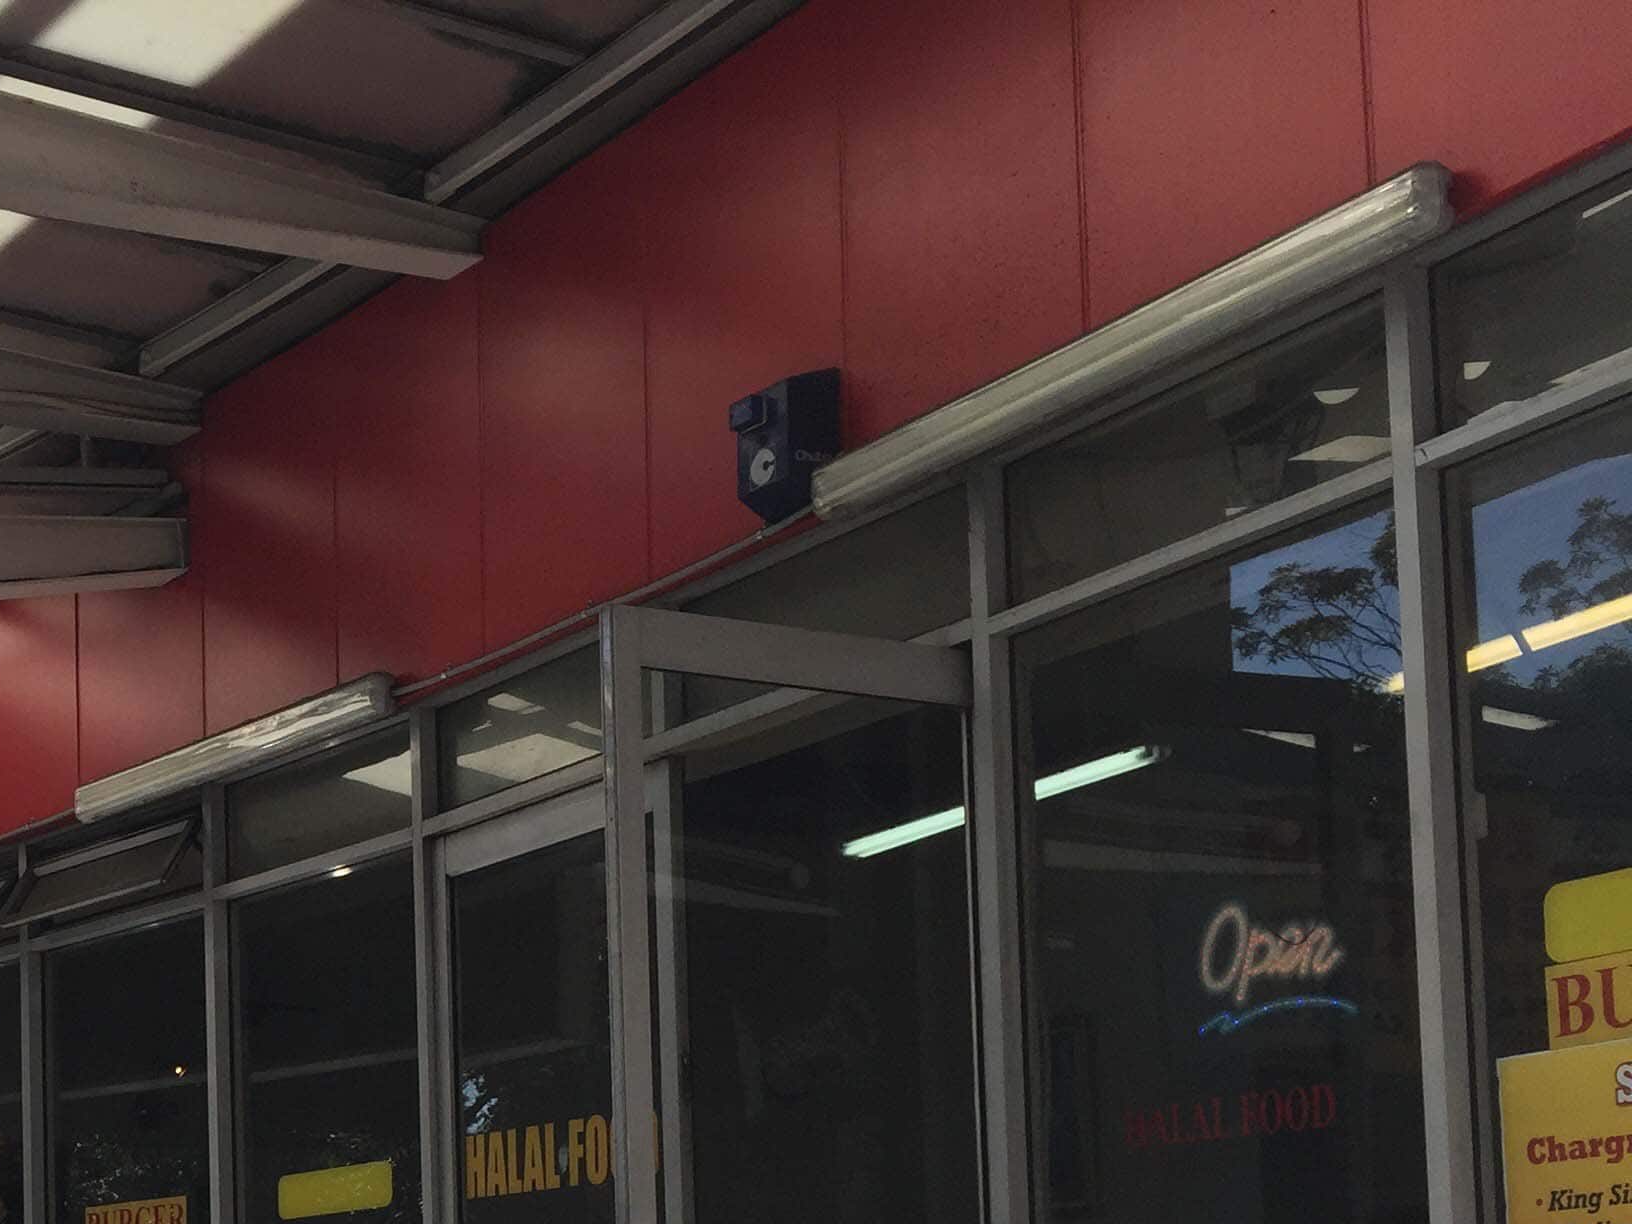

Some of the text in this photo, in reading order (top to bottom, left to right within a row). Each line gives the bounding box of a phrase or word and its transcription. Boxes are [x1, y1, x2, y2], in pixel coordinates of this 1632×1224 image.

[1200, 904, 1346, 1001] Open
[1121, 1084, 1337, 1149] HALAL FOOD
[465, 1121, 561, 1200] HALAL
[1548, 1183, 1632, 1213] King Si
